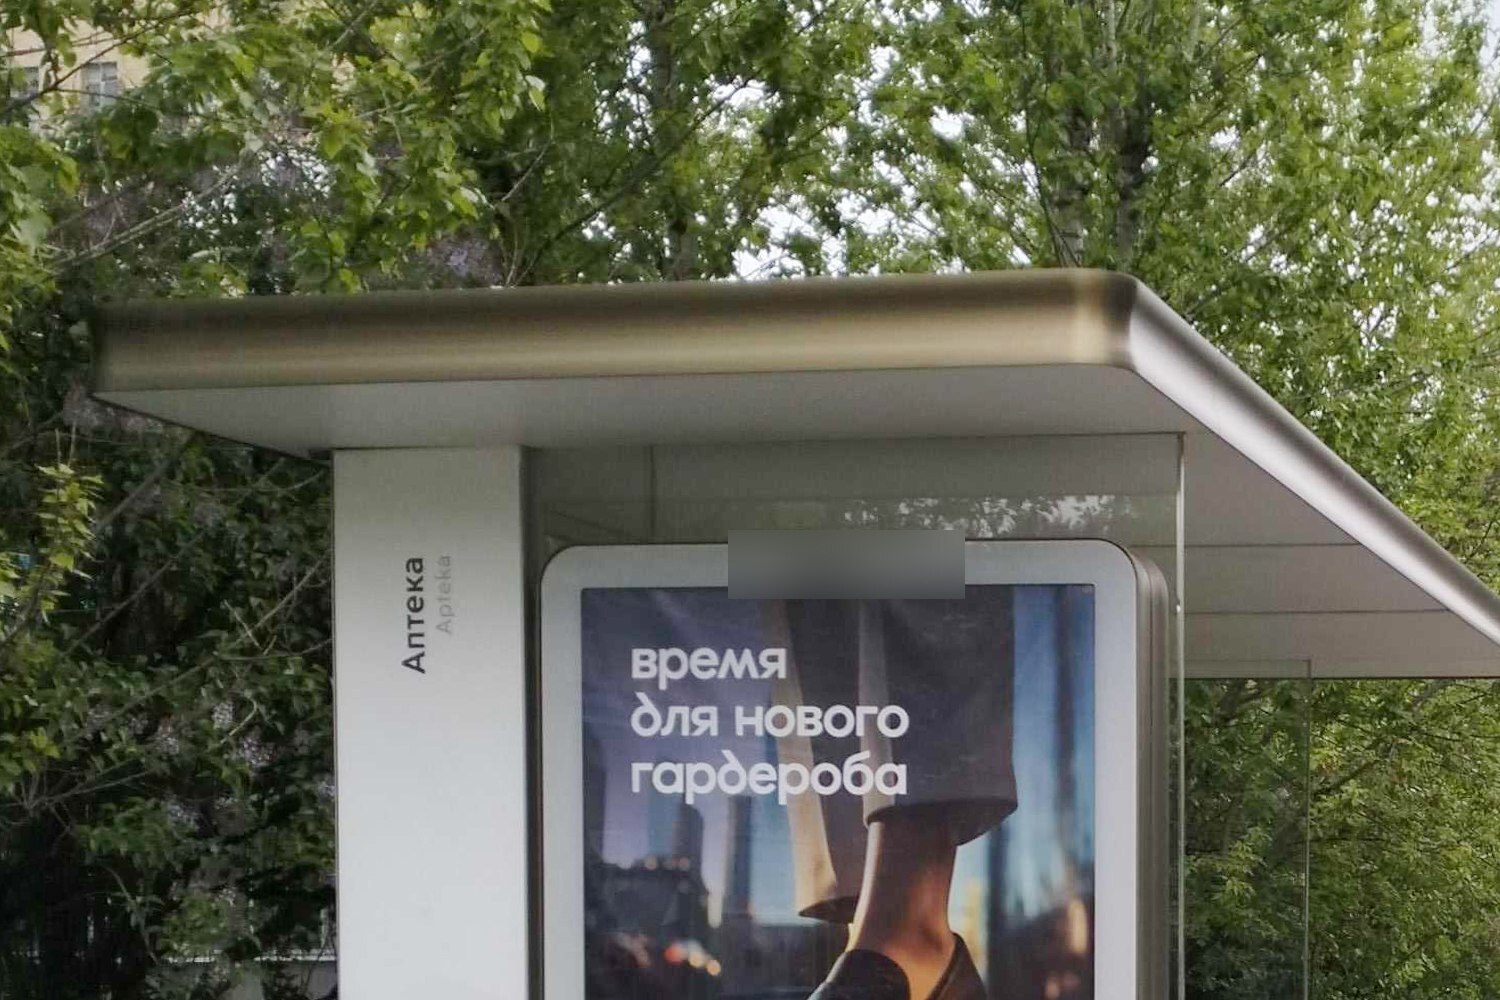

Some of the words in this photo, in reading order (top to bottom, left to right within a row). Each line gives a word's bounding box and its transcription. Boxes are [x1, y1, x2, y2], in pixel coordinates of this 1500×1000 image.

[401, 557, 426, 675] Аптека
[434, 555, 455, 635] Apteka
[631, 646, 788, 691] время
[630, 691, 719, 738] для
[734, 704, 910, 739] нового
[630, 749, 908, 806] гардероба
